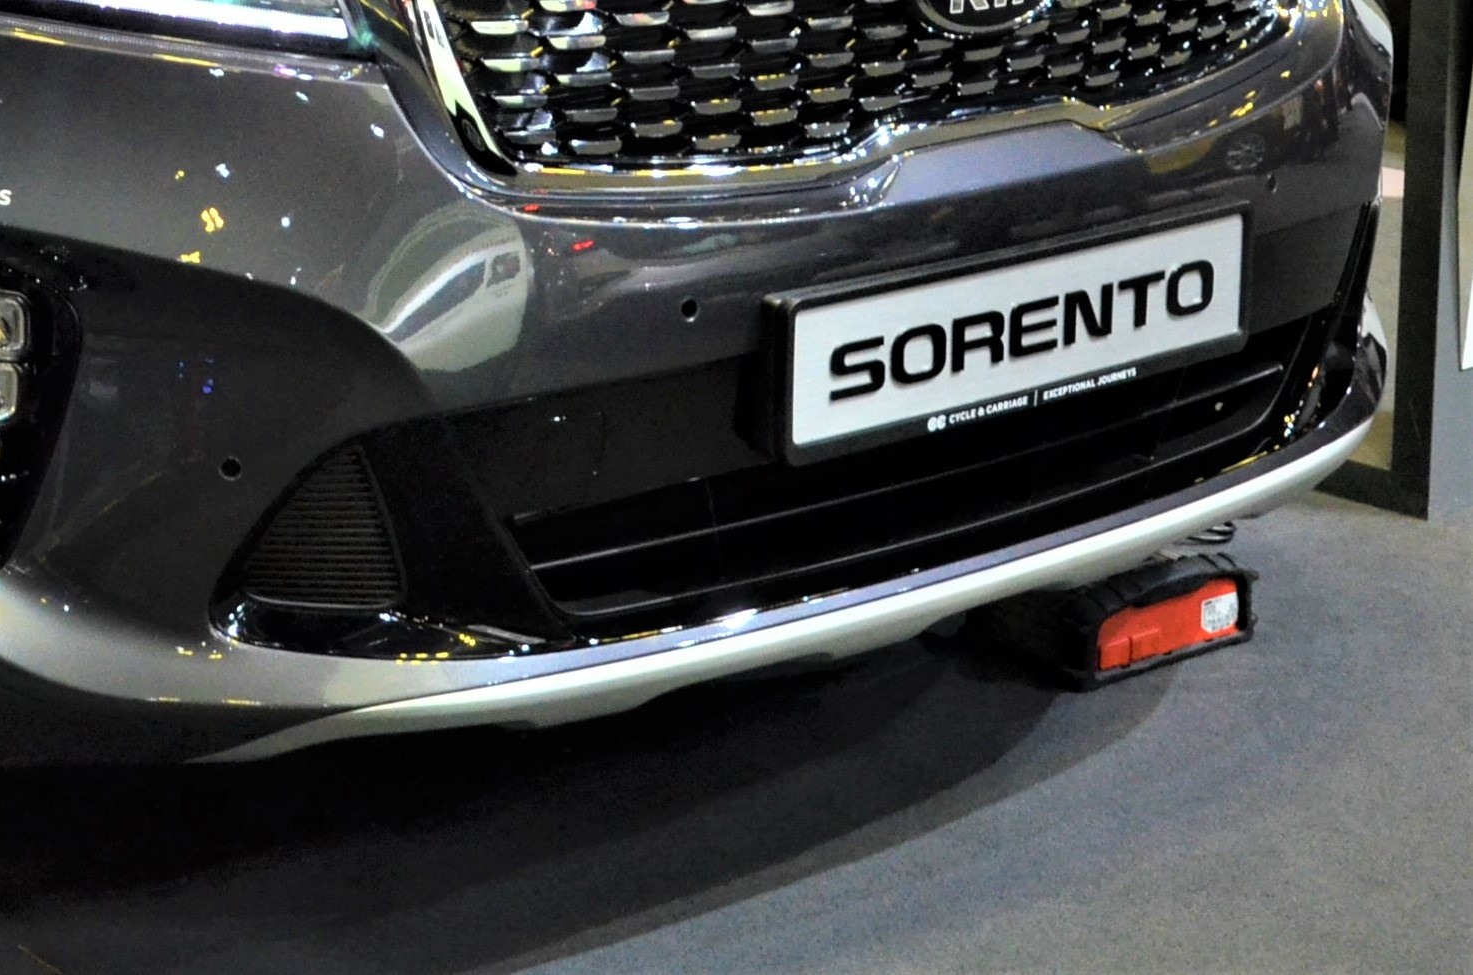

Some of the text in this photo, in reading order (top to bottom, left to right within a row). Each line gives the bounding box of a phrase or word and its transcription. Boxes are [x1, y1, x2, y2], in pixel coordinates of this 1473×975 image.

[829, 259, 1215, 402] SORENTO
[948, 408, 977, 425] CYCLE
[977, 405, 986, 417] &
[986, 395, 1029, 415] CARRIAGE
[1043, 378, 1096, 401] EXCEPTIONAL
[1097, 367, 1138, 387] JOURNEYS
